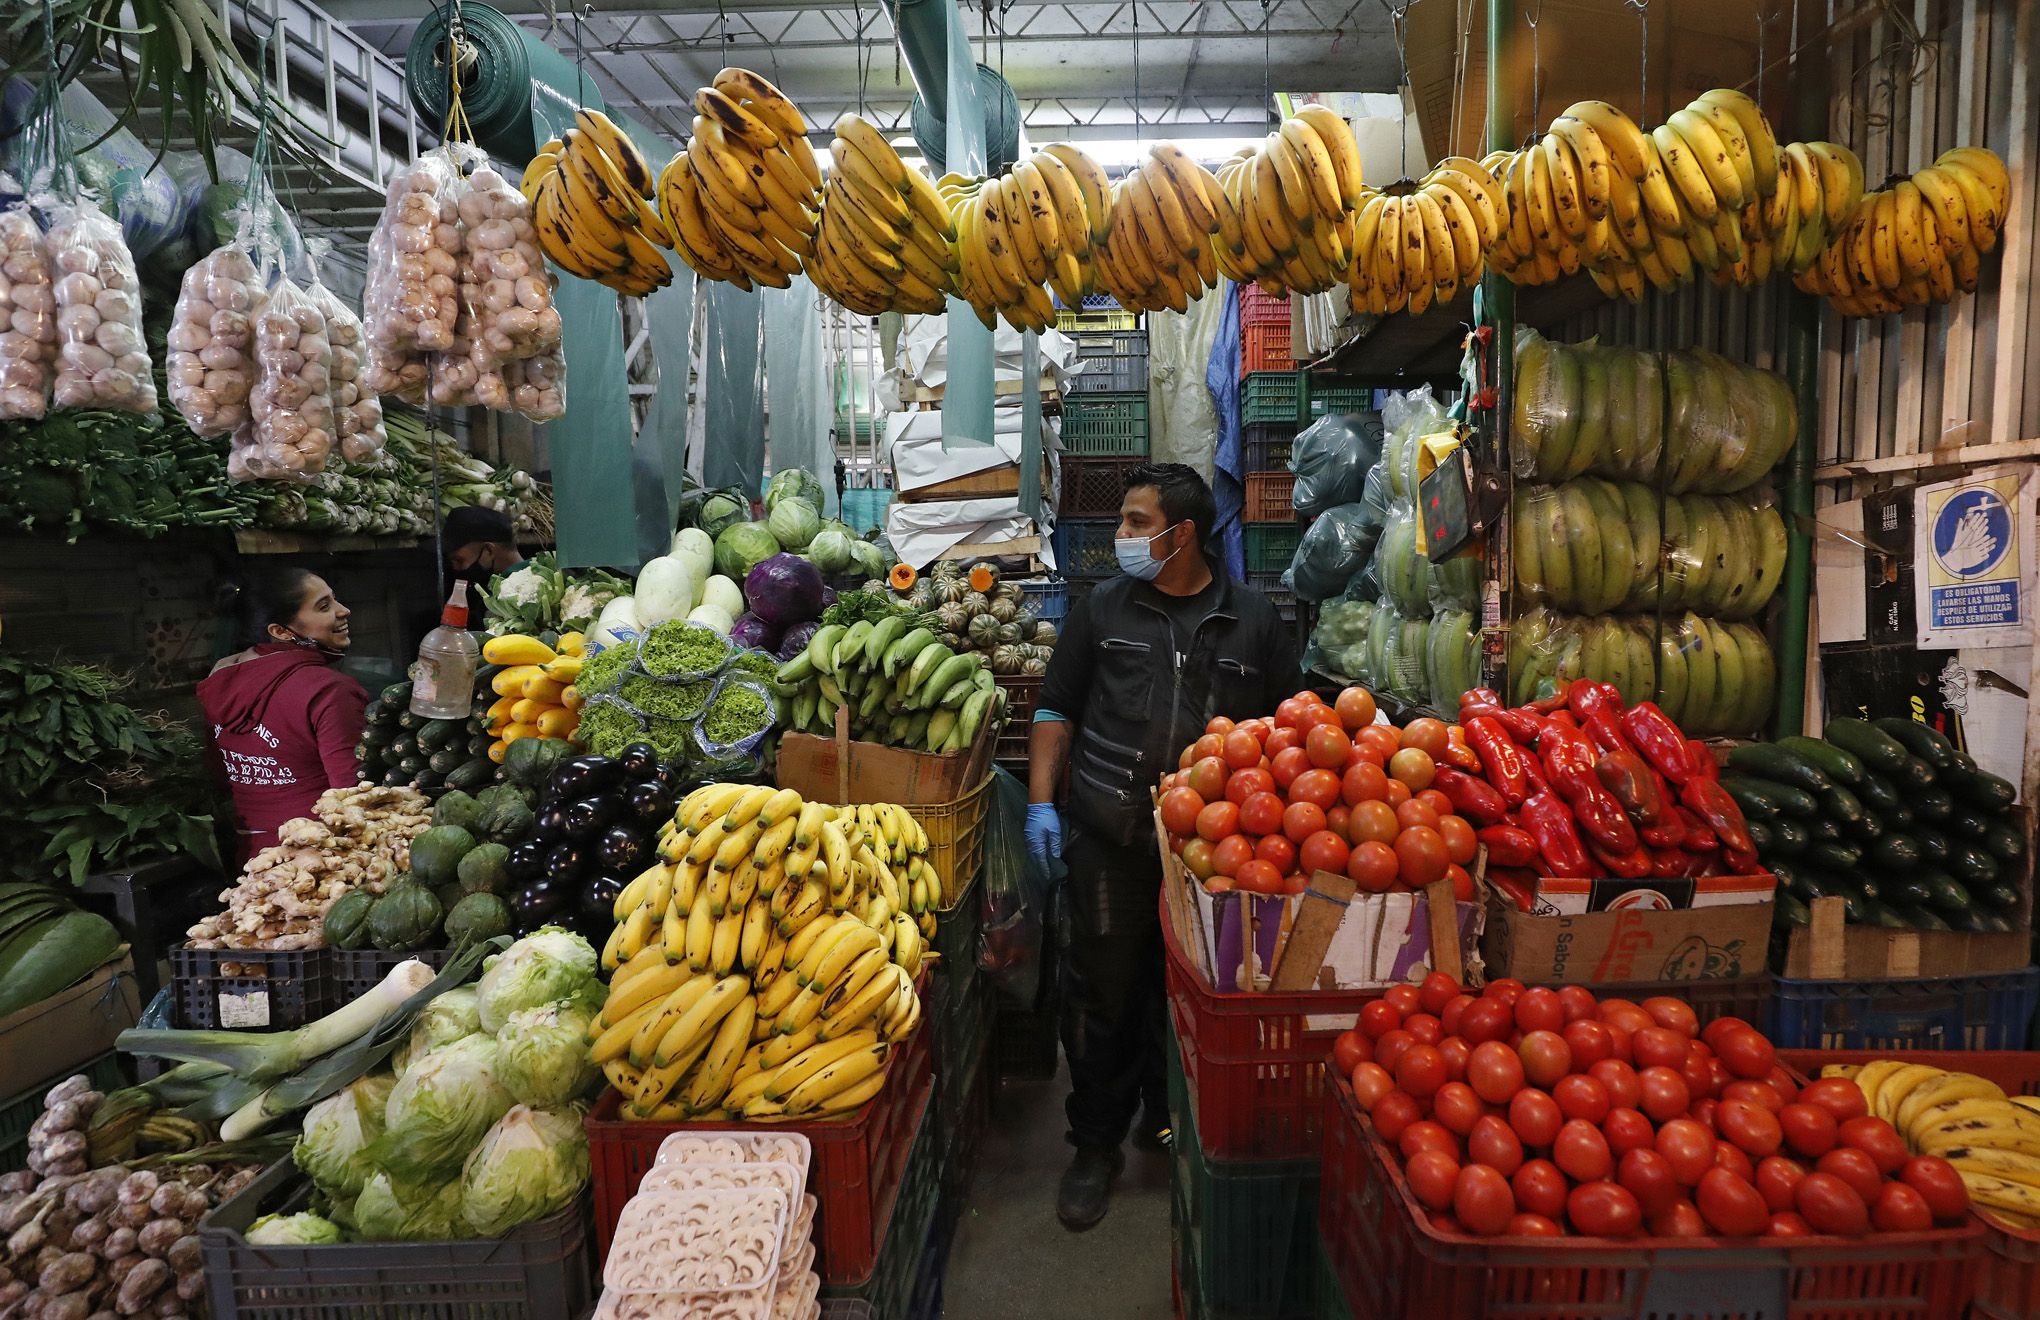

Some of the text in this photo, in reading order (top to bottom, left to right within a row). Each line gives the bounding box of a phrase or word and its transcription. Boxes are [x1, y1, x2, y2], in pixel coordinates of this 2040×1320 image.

[1945, 585, 2001, 598] ES OBLIGATORIO
[1938, 594, 2011, 607] LAVARSE LAS MANOS
[1937, 603, 2012, 616] DESPUES DE UTILIZAR
[1944, 613, 2004, 625] ESTOS SERVICIOS
[253, 723, 280, 748] NES
[229, 751, 277, 766] PICADOS
[278, 767, 292, 778] 43
[1552, 933, 1574, 979] Sabor
